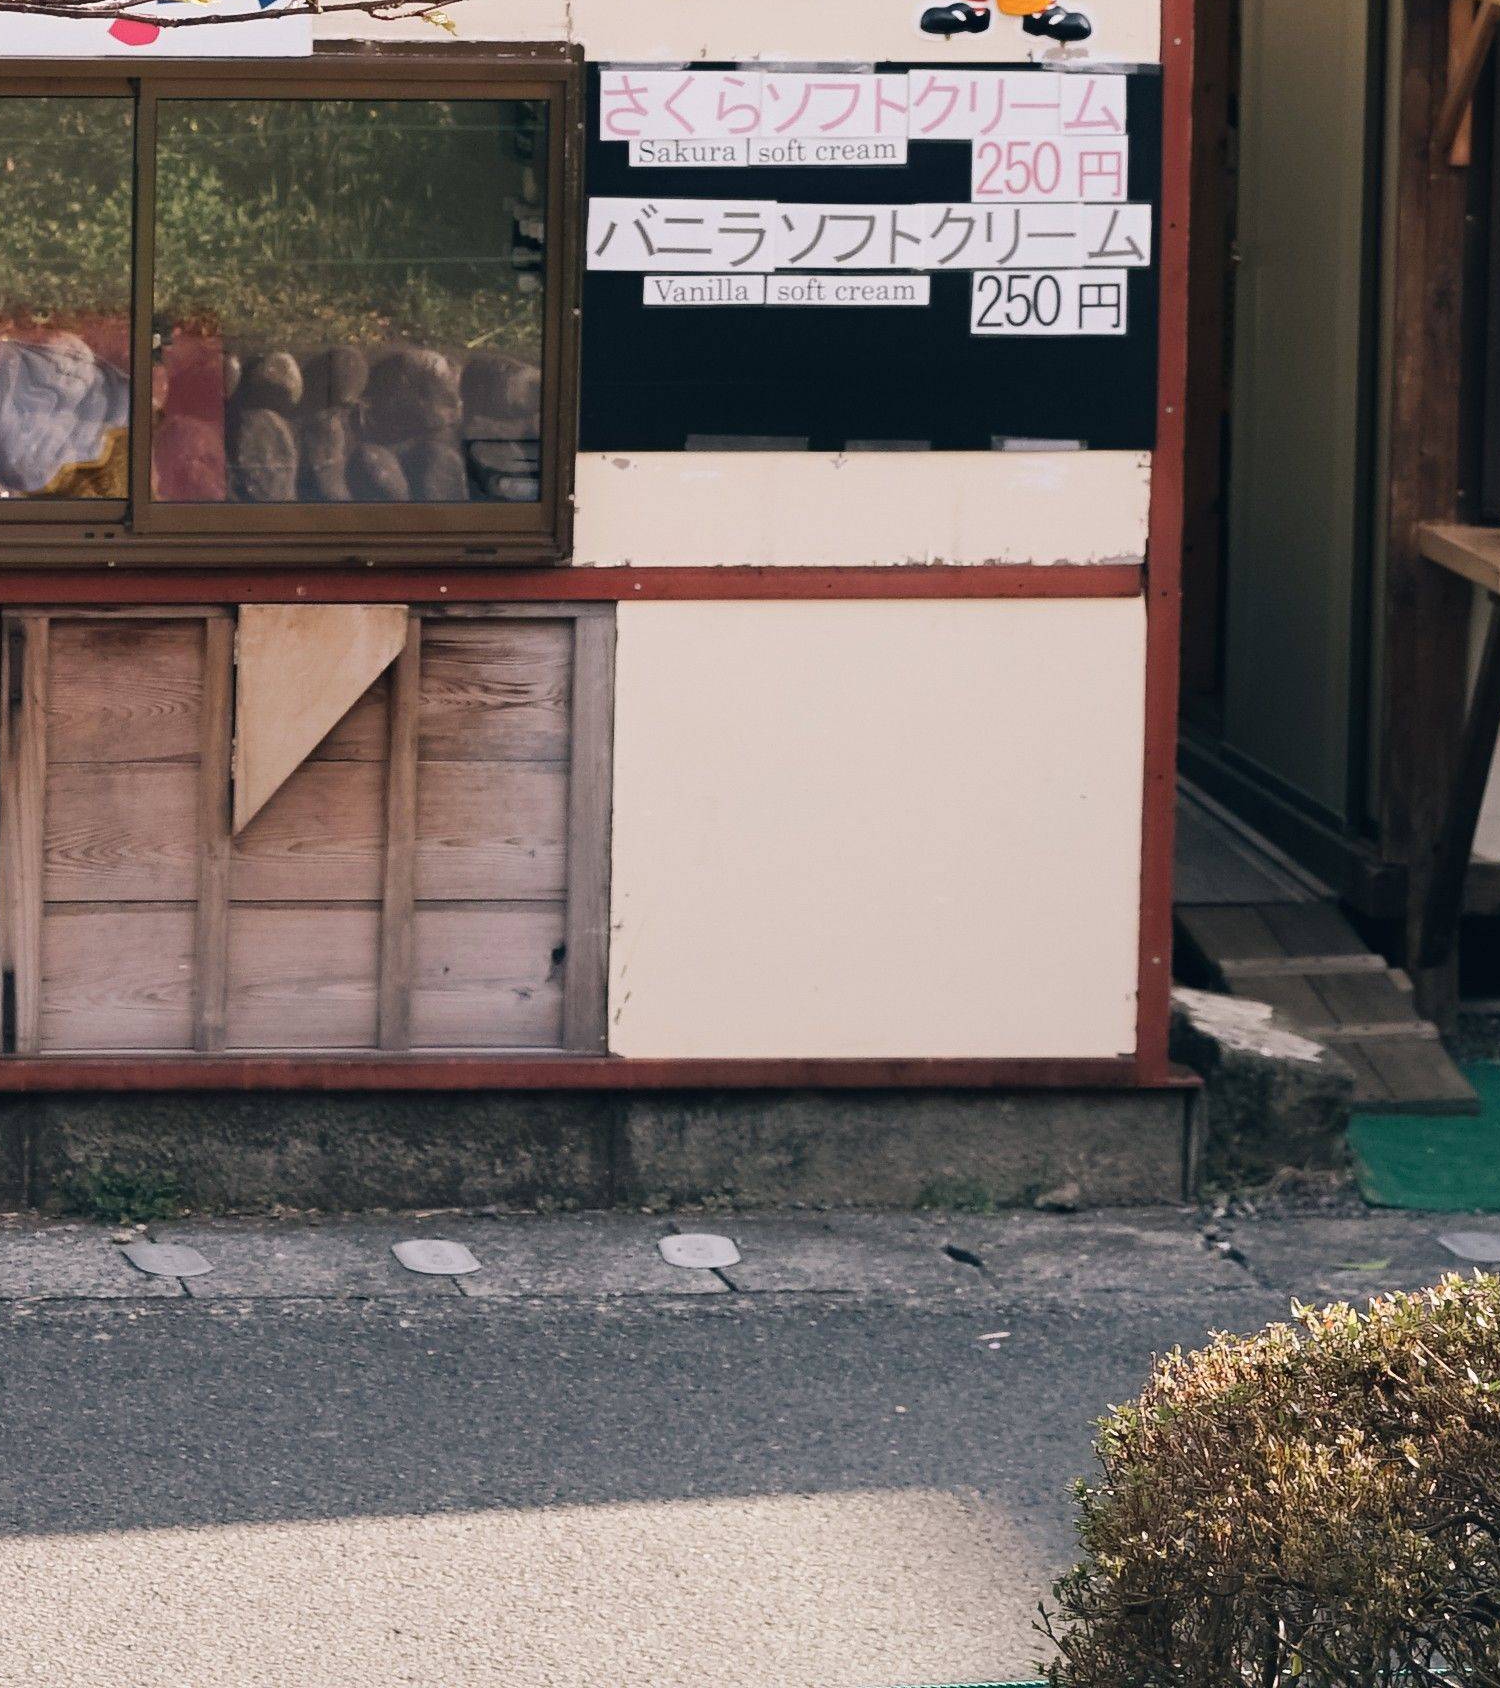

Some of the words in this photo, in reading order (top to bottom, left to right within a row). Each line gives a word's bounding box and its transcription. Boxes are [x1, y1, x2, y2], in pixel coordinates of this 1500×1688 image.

[603, 74, 1122, 136] さくらソフトクリーム
[638, 139, 736, 163] Sakura
[758, 138, 806, 162] soft
[815, 143, 897, 161] cream
[976, 140, 1122, 197] 250円
[595, 204, 1145, 267] バニラソフトクリーム
[653, 279, 750, 302] Vanilla
[777, 276, 823, 302] soft
[834, 282, 916, 301] cream
[976, 274, 1121, 329] 250円
